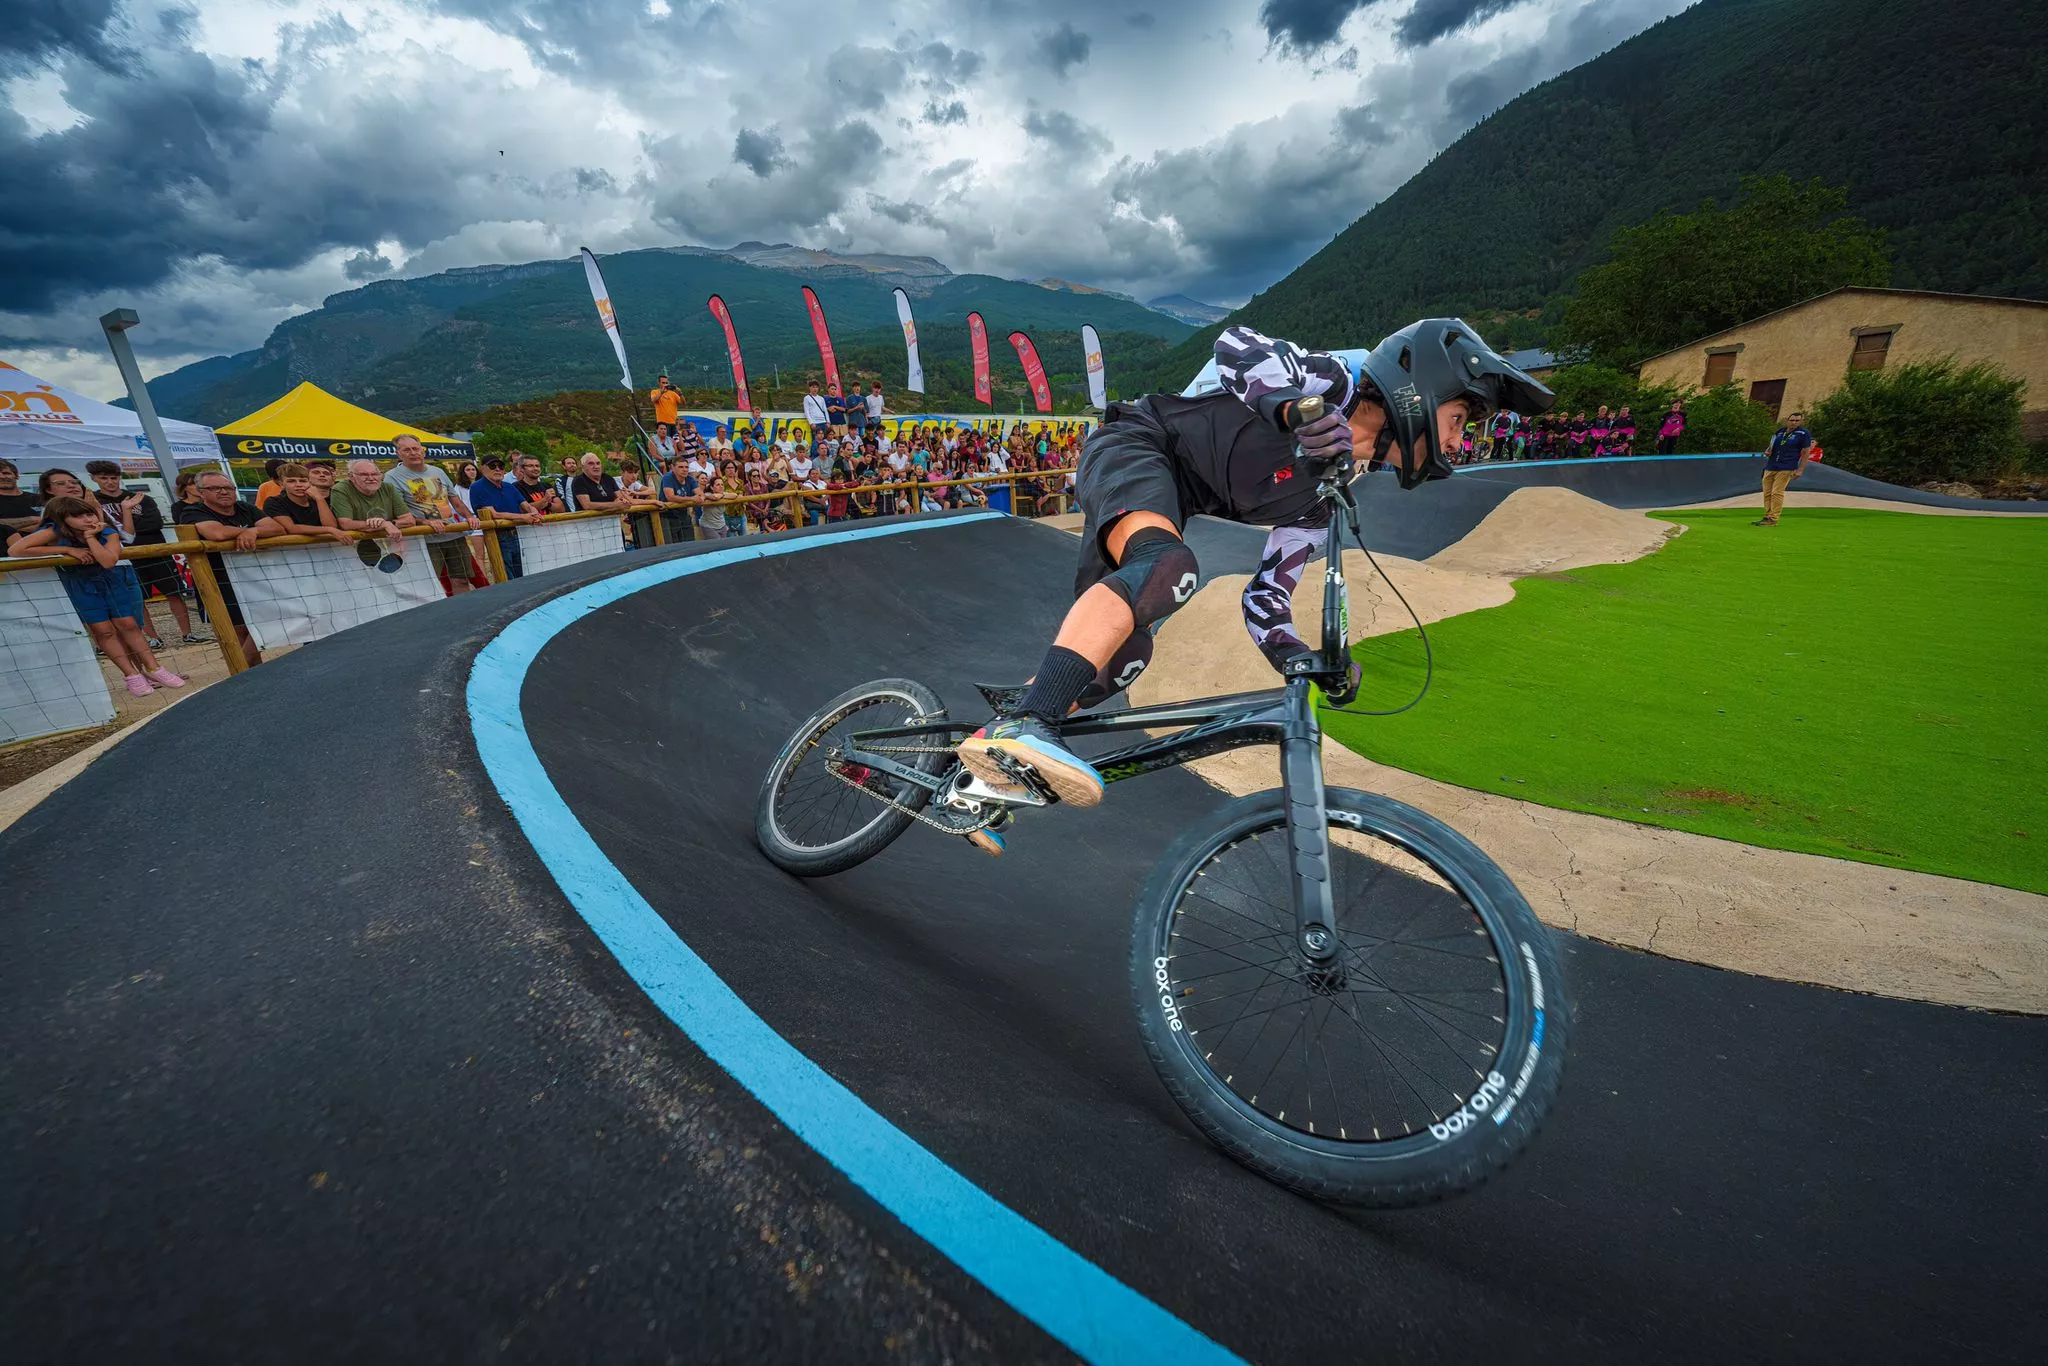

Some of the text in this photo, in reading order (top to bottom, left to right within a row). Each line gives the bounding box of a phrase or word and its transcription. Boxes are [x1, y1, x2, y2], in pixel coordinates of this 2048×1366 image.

[1397, 381, 1422, 416] FLY
[168, 445, 204, 453] illanúa
[237, 439, 316, 455] embou
[329, 442, 397, 456] embou
[422, 444, 467, 456] mbou
[1154, 956, 1183, 1032] box one
[1428, 1070, 1506, 1141] box one
